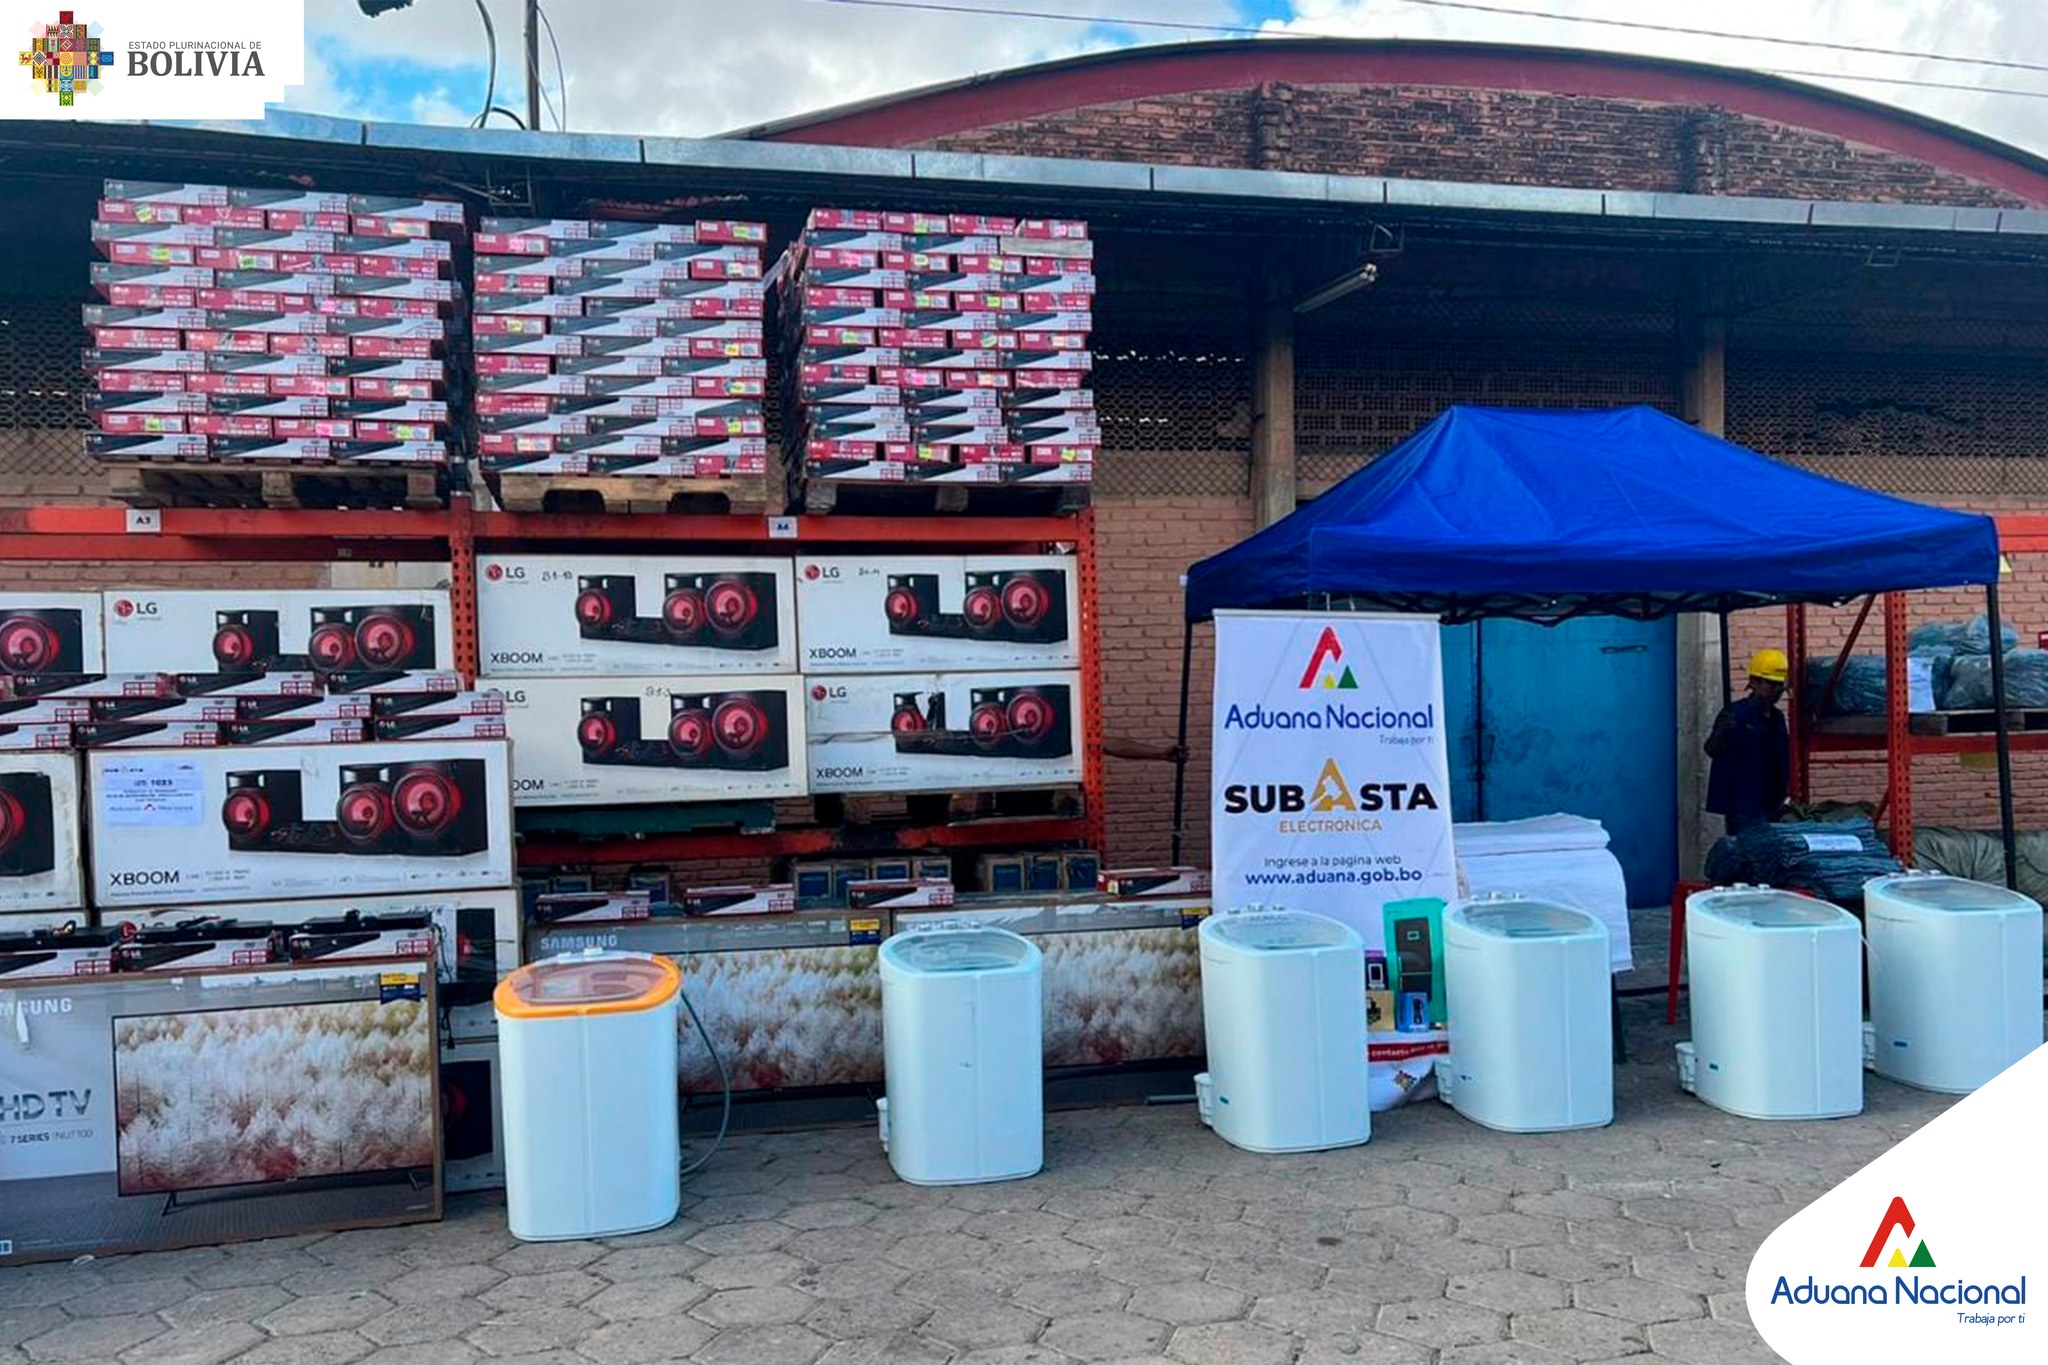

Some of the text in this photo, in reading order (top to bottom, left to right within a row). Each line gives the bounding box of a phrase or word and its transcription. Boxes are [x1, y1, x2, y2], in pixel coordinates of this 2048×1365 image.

[506, 566, 525, 579] LG
[822, 566, 840, 578] LG
[136, 602, 157, 615] LG
[490, 652, 543, 664] XBOOM
[809, 648, 857, 660] XBOOM
[506, 690, 525, 703] LG
[829, 687, 847, 698] LG
[1224, 704, 1434, 730] Aduana Nacional
[816, 767, 863, 779] XBOOM
[1264, 857, 1309, 868] Ingrese
[1311, 858, 1318, 866] a
[1320, 856, 1330, 866] la
[1374, 855, 1402, 865] web
[110, 870, 180, 886] XBOOM
[1245, 868, 1422, 885] www.aduana.gob.bo
[540, 934, 618, 950] SAMSUNG
